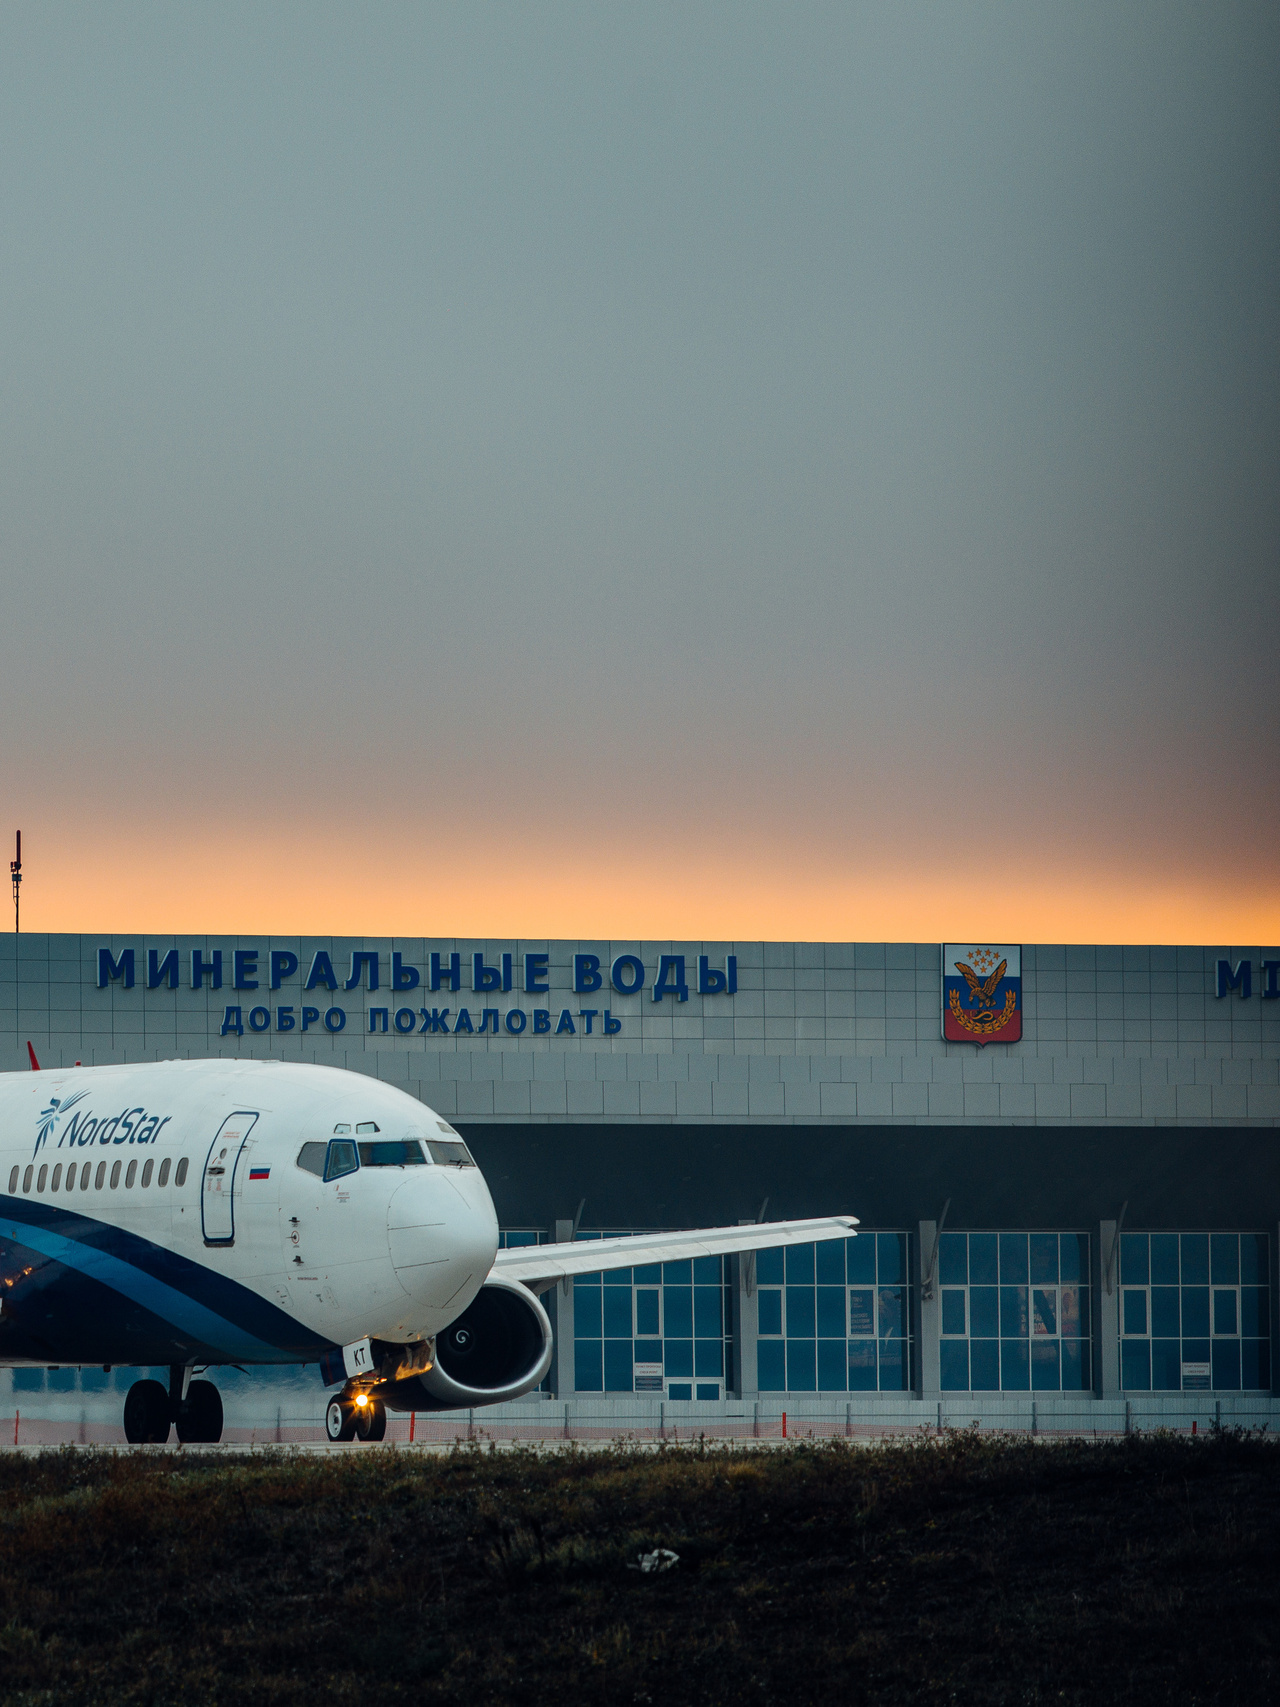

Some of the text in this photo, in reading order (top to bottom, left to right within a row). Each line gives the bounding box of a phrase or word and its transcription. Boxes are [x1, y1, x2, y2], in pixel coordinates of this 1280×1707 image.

[96, 948, 738, 1002] МИНЕРАЛЬНЫЕ ВОДЫ
[220, 1005, 622, 1036] ДОБРО ПОЖАЛОВАТЬ
[58, 1107, 173, 1148] NordStar
[353, 1347, 366, 1367] KT
